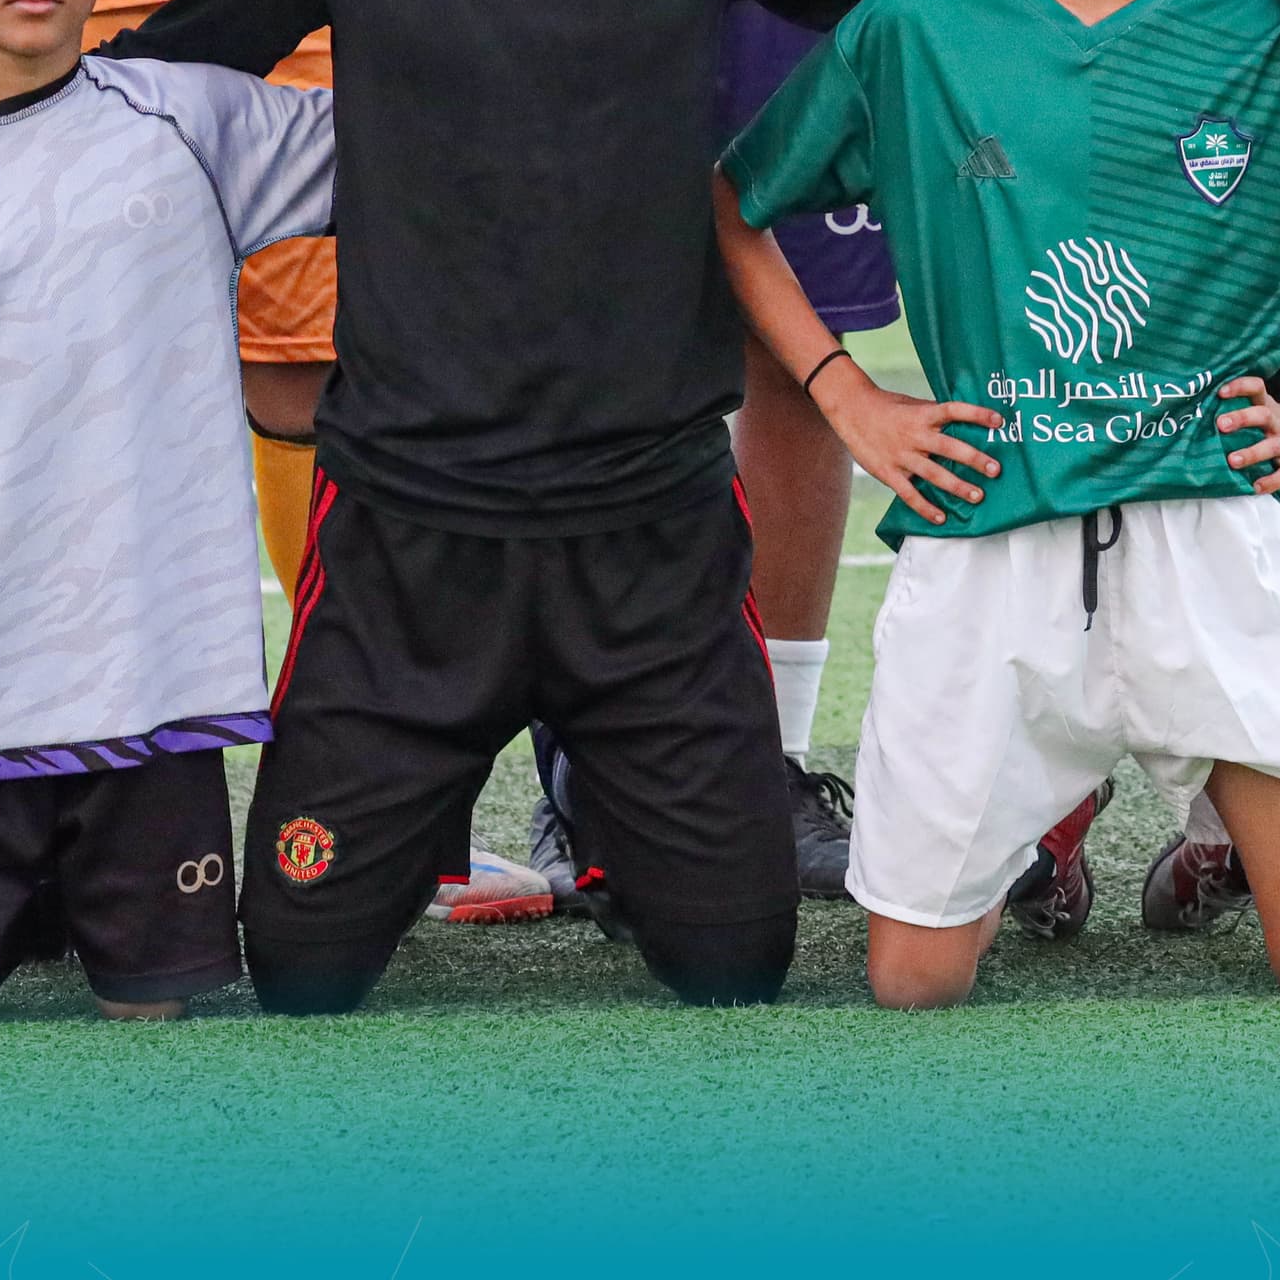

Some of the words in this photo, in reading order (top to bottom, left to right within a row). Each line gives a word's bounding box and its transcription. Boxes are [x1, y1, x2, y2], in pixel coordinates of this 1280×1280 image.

[1057, 372, 1148, 409] الأحمر
[1032, 414, 1096, 443] Sea
[283, 820, 330, 846] MANCHESTER
[284, 863, 318, 878] UNITED
